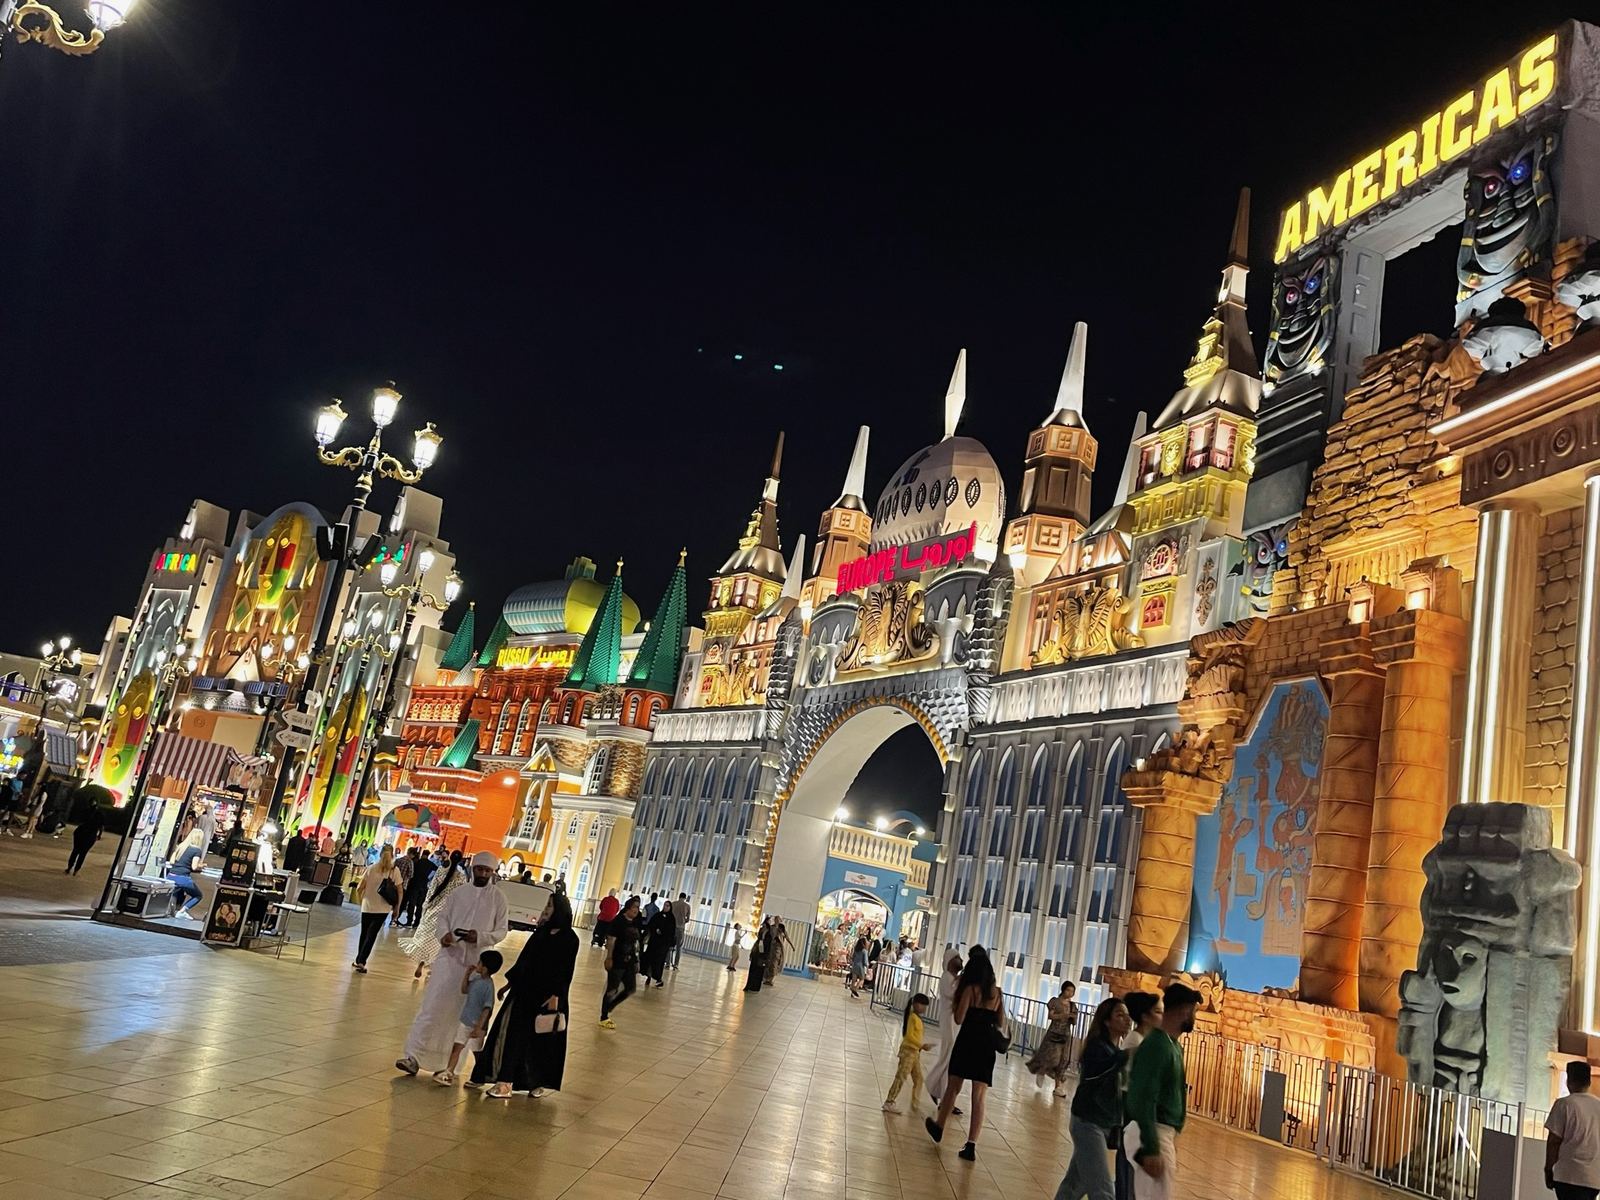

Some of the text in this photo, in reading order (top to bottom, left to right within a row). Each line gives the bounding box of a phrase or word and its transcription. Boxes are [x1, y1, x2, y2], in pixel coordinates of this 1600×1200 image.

[1274, 34, 1557, 265] AMERICAS
[155, 552, 197, 571] AFRICA
[836, 545, 897, 596] EUROPE
[496, 646, 531, 667] RUSSIA
